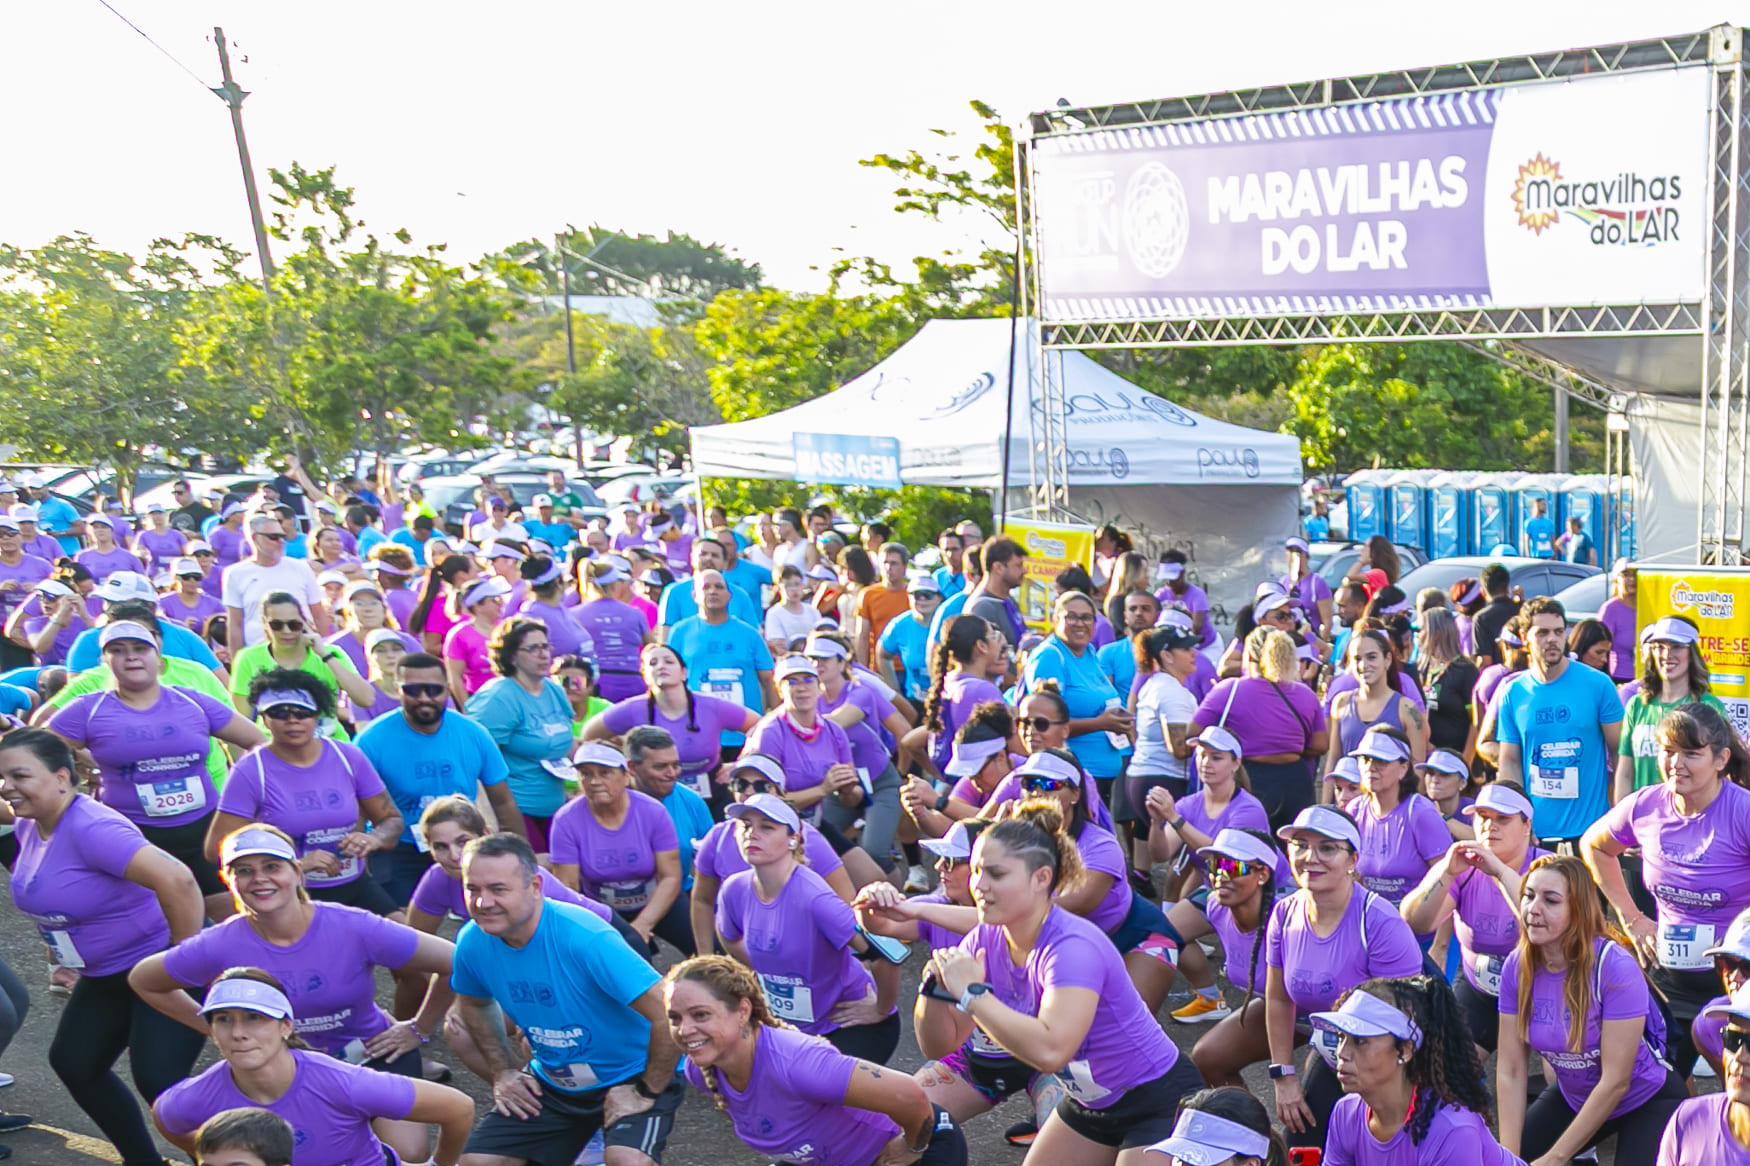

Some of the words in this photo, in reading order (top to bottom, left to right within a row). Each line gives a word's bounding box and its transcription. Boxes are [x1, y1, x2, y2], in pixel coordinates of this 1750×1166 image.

[1206, 155, 1469, 224] MARAVILHAS
[1525, 171, 1682, 211] Maravilhas
[1589, 217, 1621, 246] do
[1626, 206, 1681, 245] LAR
[1260, 226, 1321, 276] DO
[1326, 219, 1408, 272] LAR
[1677, 590, 1733, 603] Maravilhas
[137, 753, 200, 769] CELEBRAR
[138, 761, 191, 773] CORRIDA
[1542, 780, 1562, 790] 154
[156, 792, 194, 809] 2028
[1657, 886, 1721, 902] CELEBRAR
[1667, 943, 1690, 957] 311
[528, 1026, 583, 1040] CELEBRAR
